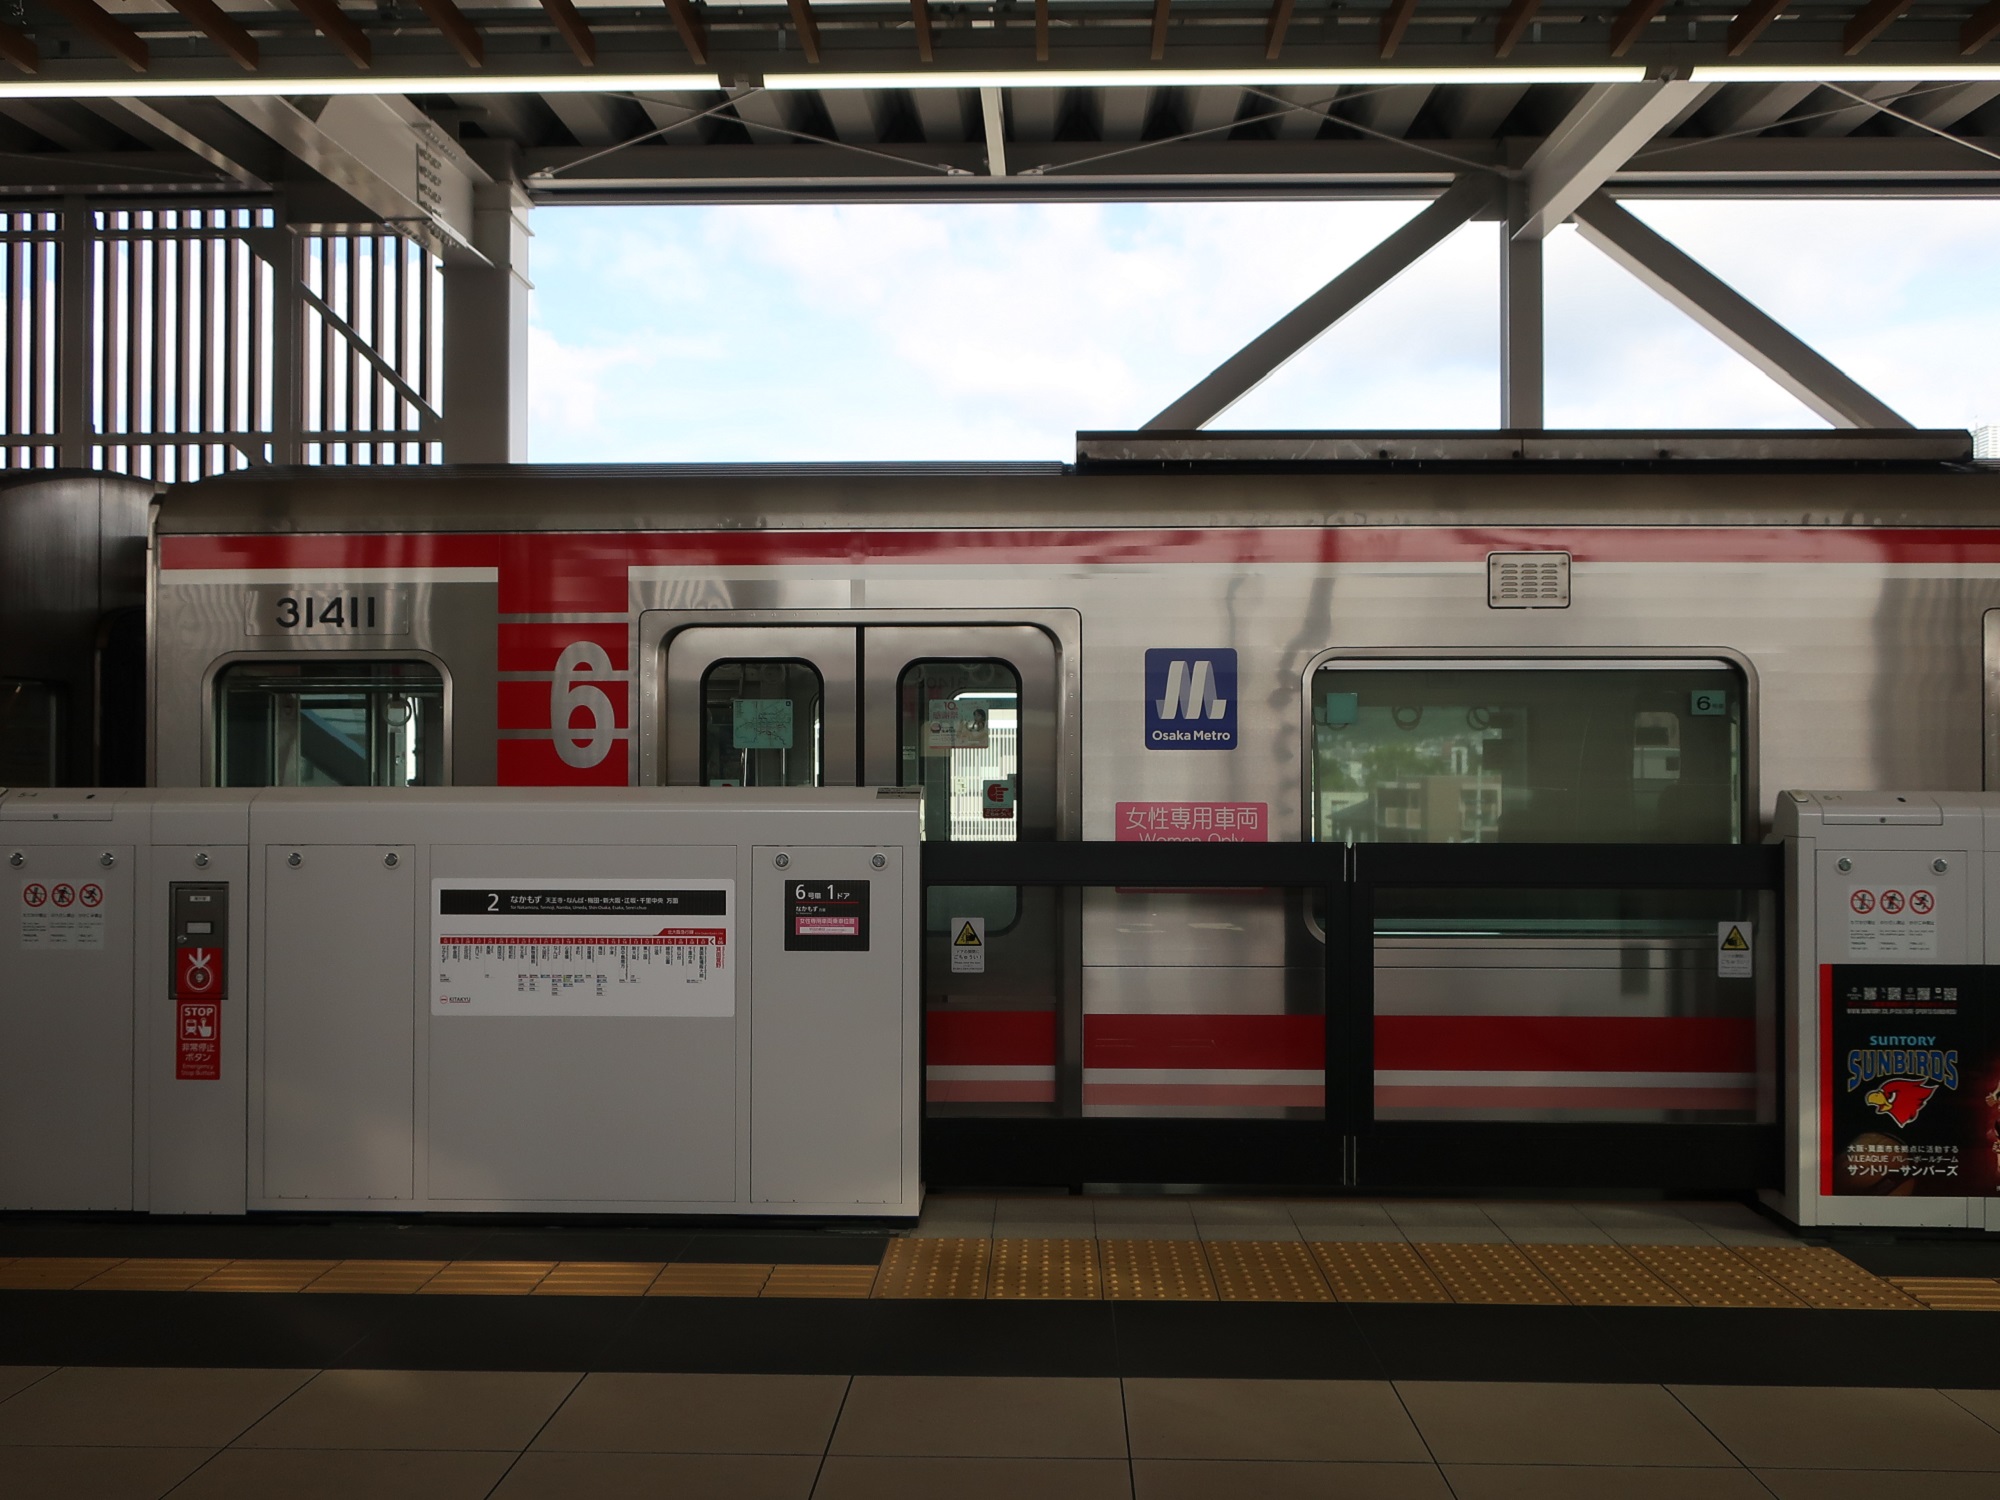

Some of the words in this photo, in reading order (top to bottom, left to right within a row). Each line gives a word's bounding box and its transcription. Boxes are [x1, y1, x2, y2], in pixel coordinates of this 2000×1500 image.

[275, 596, 376, 628] 31411
[549, 640, 616, 769] 6
[1152, 730, 1191, 741] Osaka
[1193, 730, 1231, 741] Metro
[1125, 806, 1258, 830] 女性専用車両
[486, 893, 500, 912] 2
[510, 895, 542, 904] なかもず
[184, 1007, 213, 1016] STOP
[181, 1042, 216, 1053] 非常停止
[185, 1053, 212, 1062] ボタン
[1847, 1049, 1959, 1093] SUNBIRDS
[1847, 1154, 1889, 1163] V.LEAGUE
[1891, 1154, 1959, 1163] バレーボールチーム
[1847, 1164, 1959, 1177] サントリーサンバーズ
